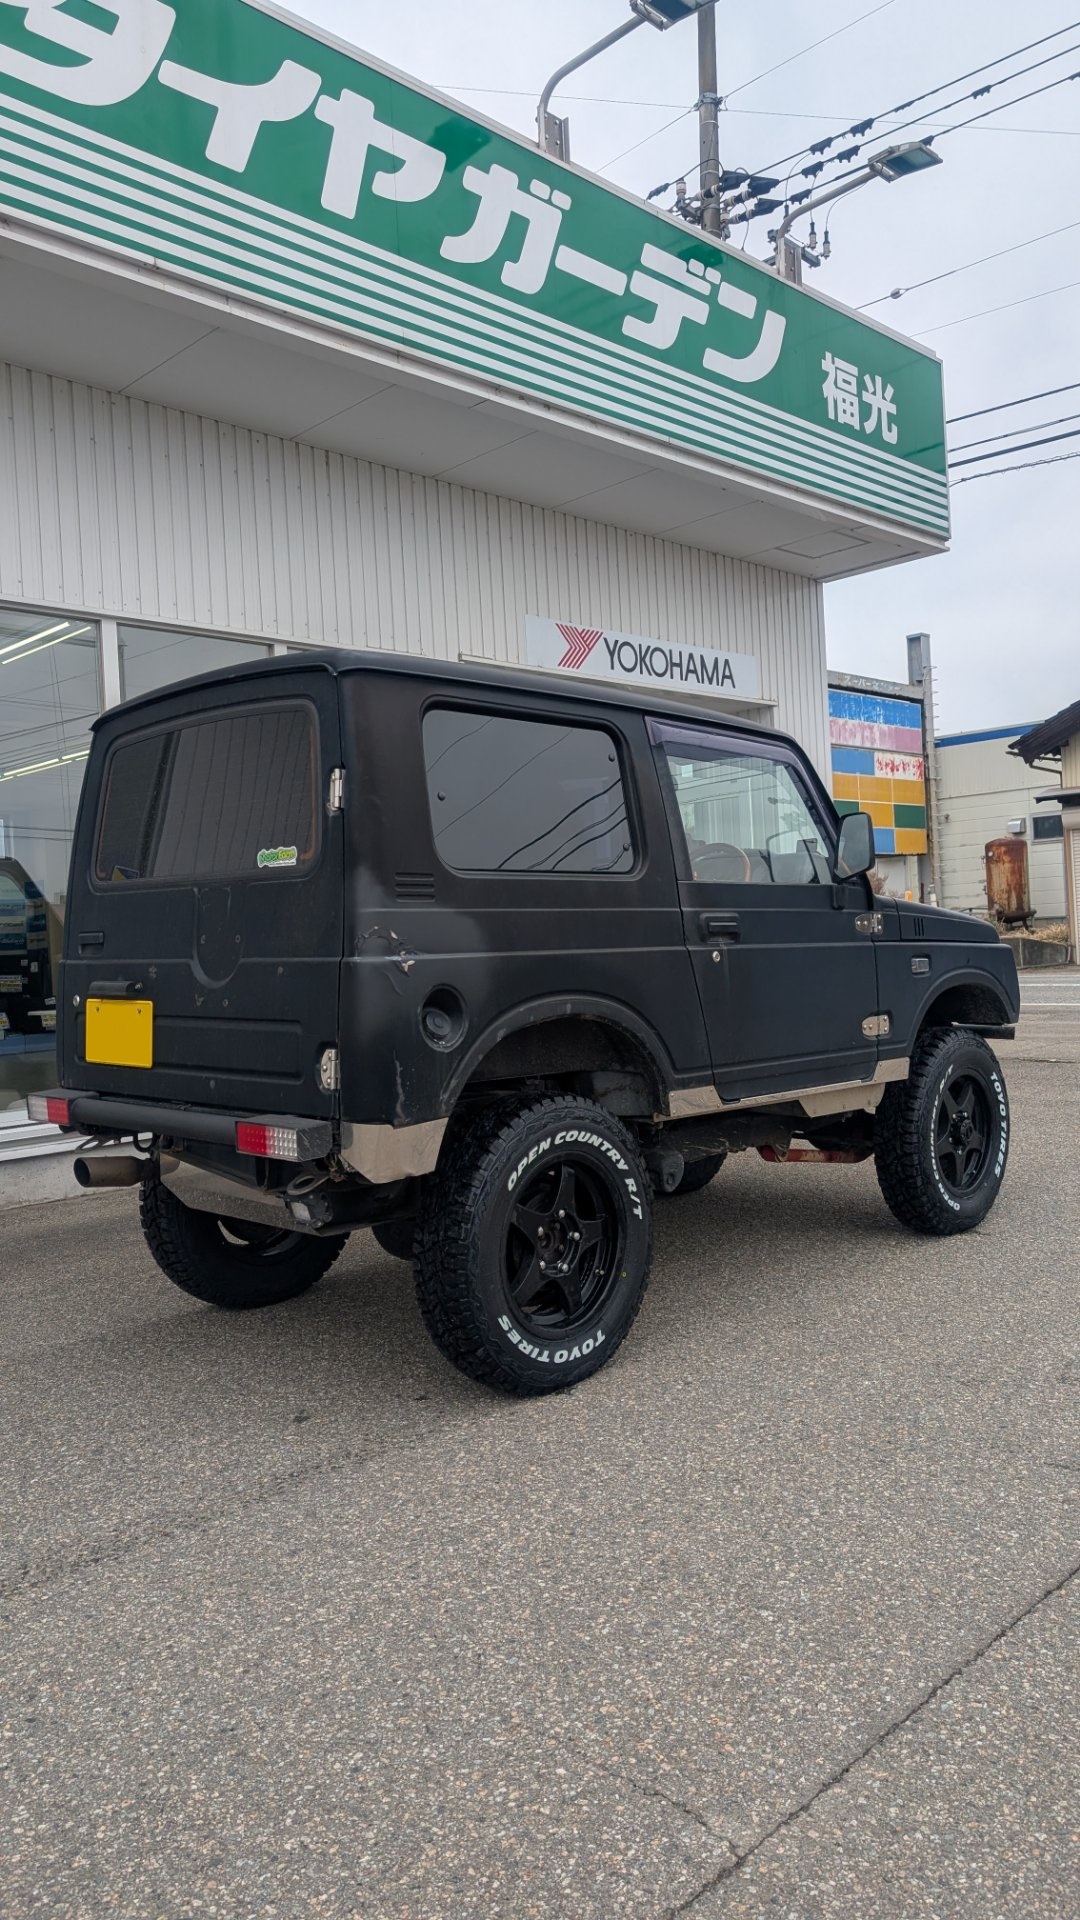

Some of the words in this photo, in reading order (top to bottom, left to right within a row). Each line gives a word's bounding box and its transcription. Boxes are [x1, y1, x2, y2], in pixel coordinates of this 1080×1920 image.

[0, 0, 787, 383] タイヤガーデン
[822, 351, 898, 445] 福光
[603, 637, 736, 689] YOKOHAMA
[990, 1071, 1007, 1117] TOYO
[507, 1136, 552, 1192] OPEN
[553, 1129, 630, 1172] COUNTRY
[624, 1177, 644, 1220] R/T
[994, 1120, 1007, 1178] TIRES
[497, 1314, 551, 1364] TIRES
[553, 1329, 606, 1364] TOYO
